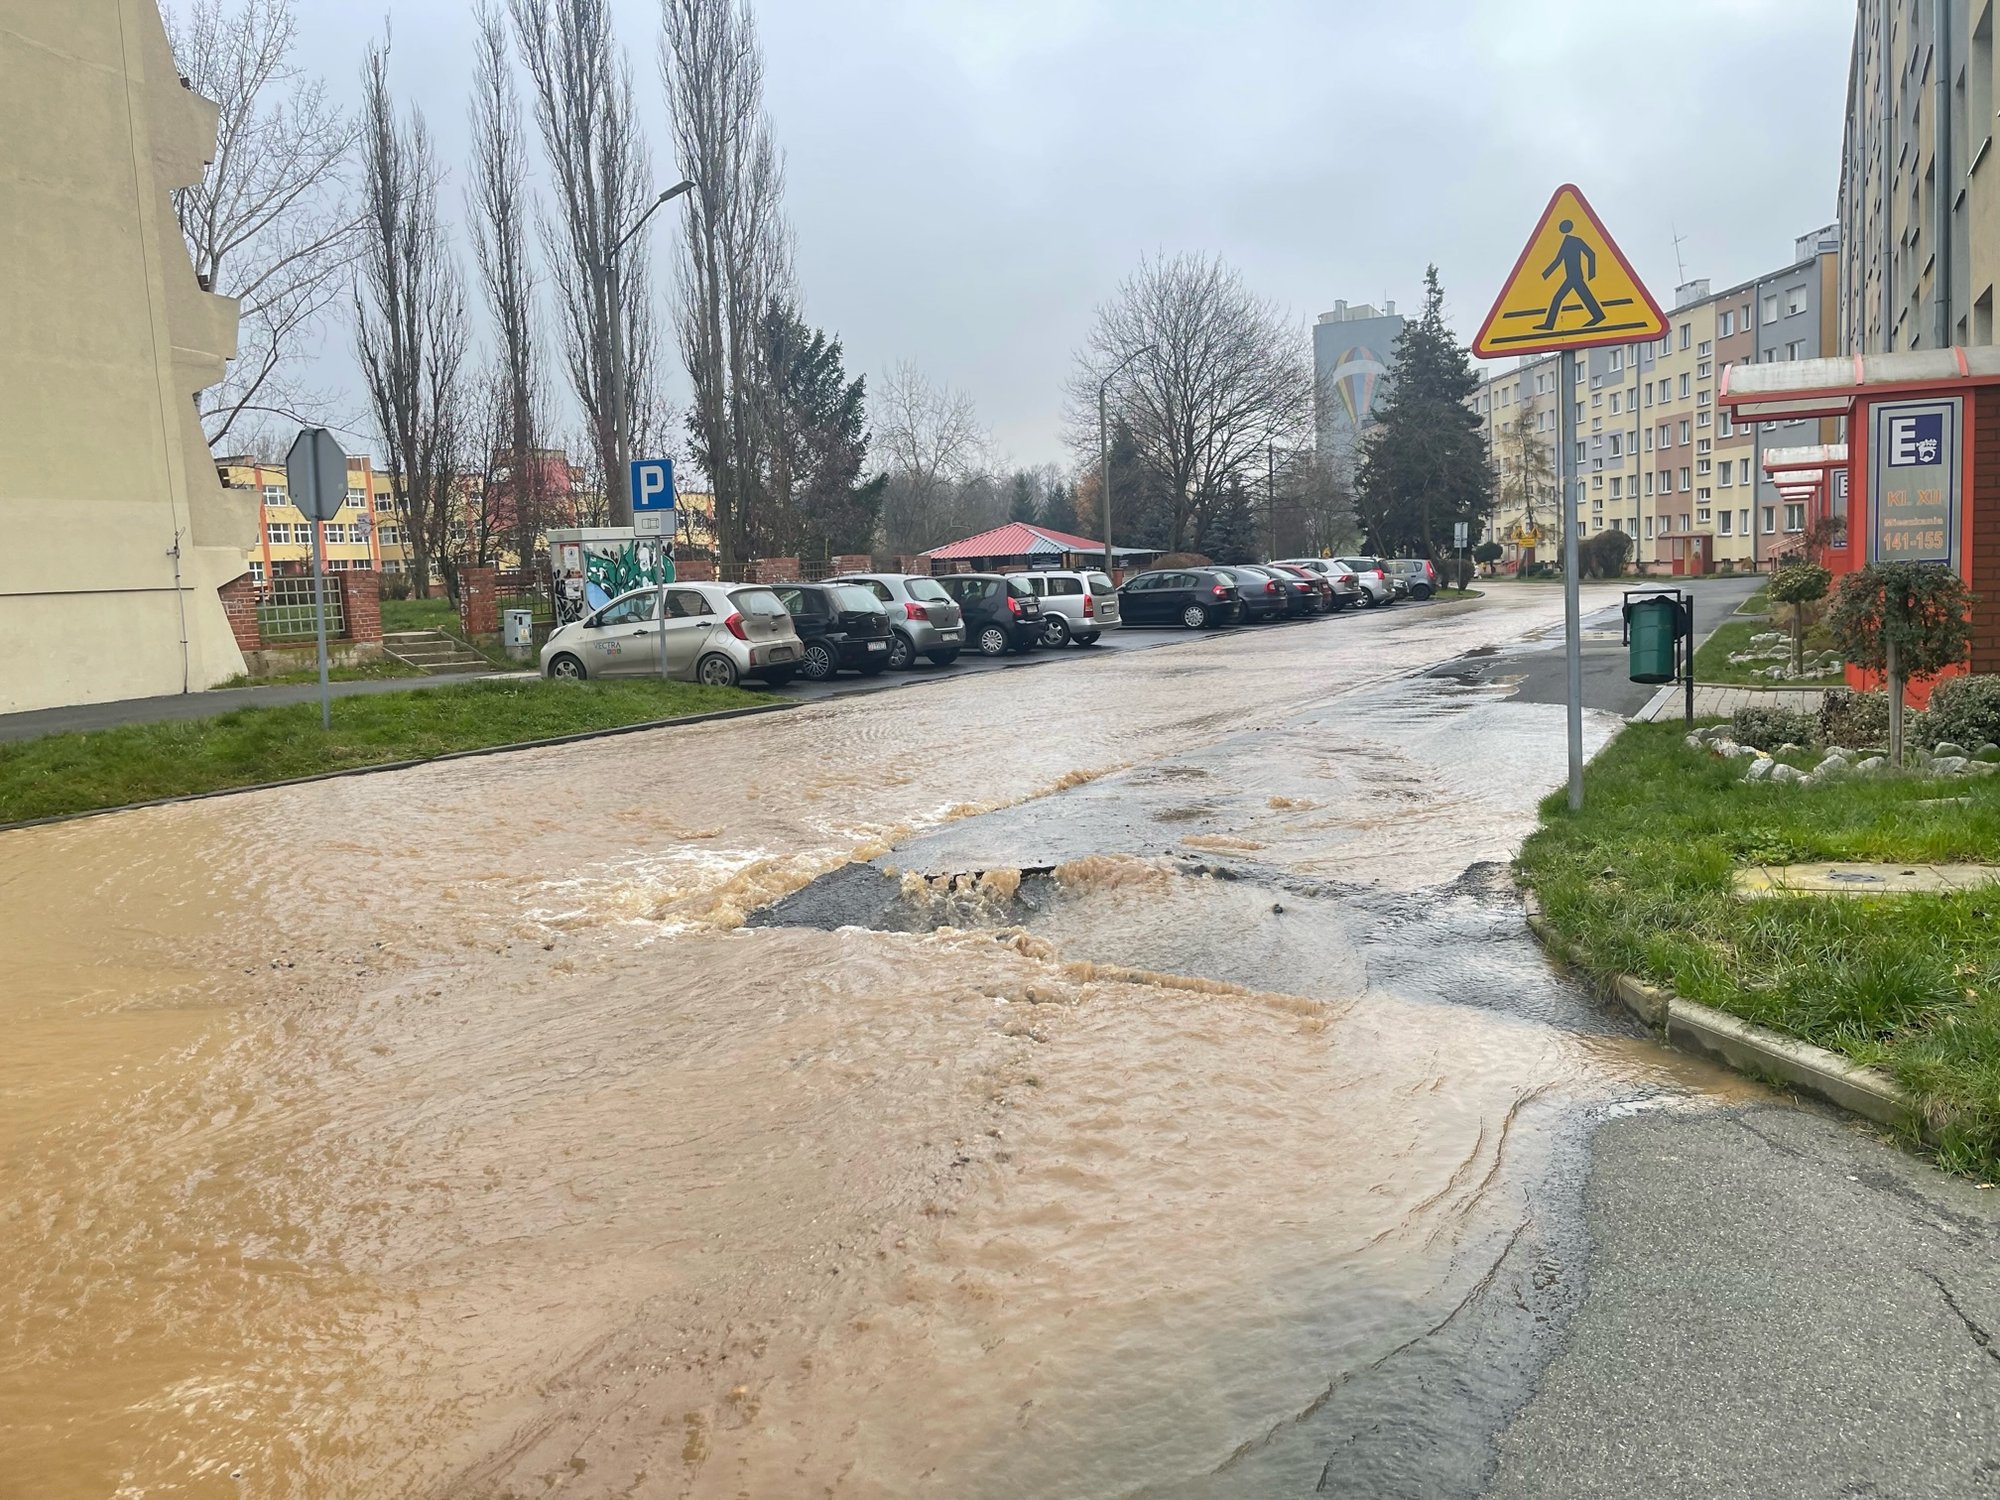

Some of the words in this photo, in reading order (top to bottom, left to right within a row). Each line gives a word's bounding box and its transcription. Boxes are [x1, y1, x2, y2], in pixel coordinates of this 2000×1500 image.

[1891, 418, 1916, 465] E
[640, 465, 664, 505] P
[1916, 487, 1942, 506] XII
[1884, 530, 1944, 551] 141-155
[593, 641, 621, 650] VECTRA
